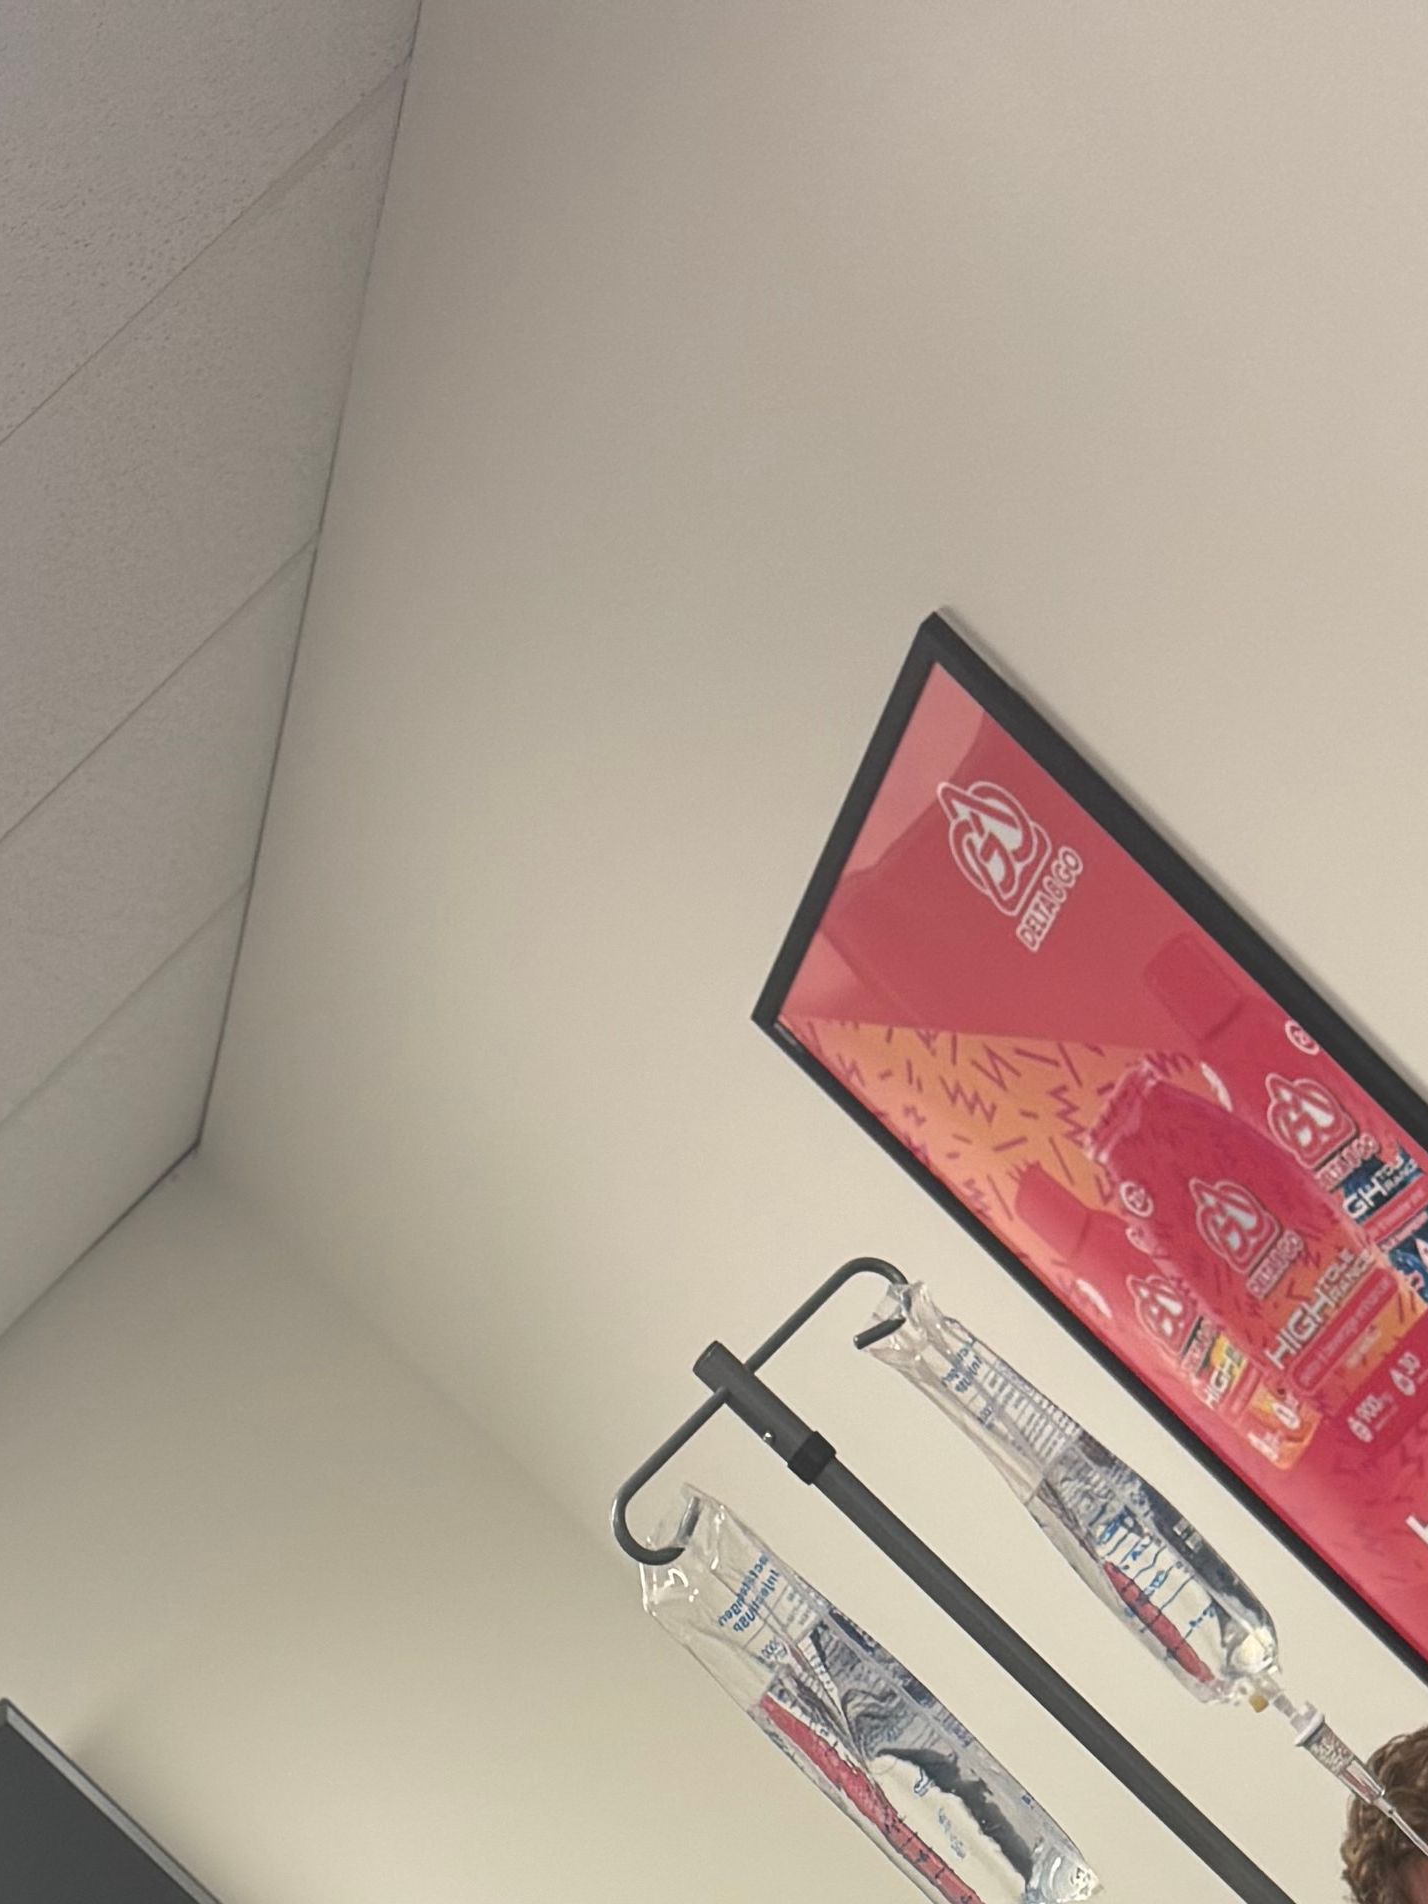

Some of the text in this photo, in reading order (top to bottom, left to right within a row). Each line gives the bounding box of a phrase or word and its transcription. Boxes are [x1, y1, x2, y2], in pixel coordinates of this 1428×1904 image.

[1011, 844, 1086, 952] DELTA 8 GO
[1262, 1286, 1336, 1370] HIGH
